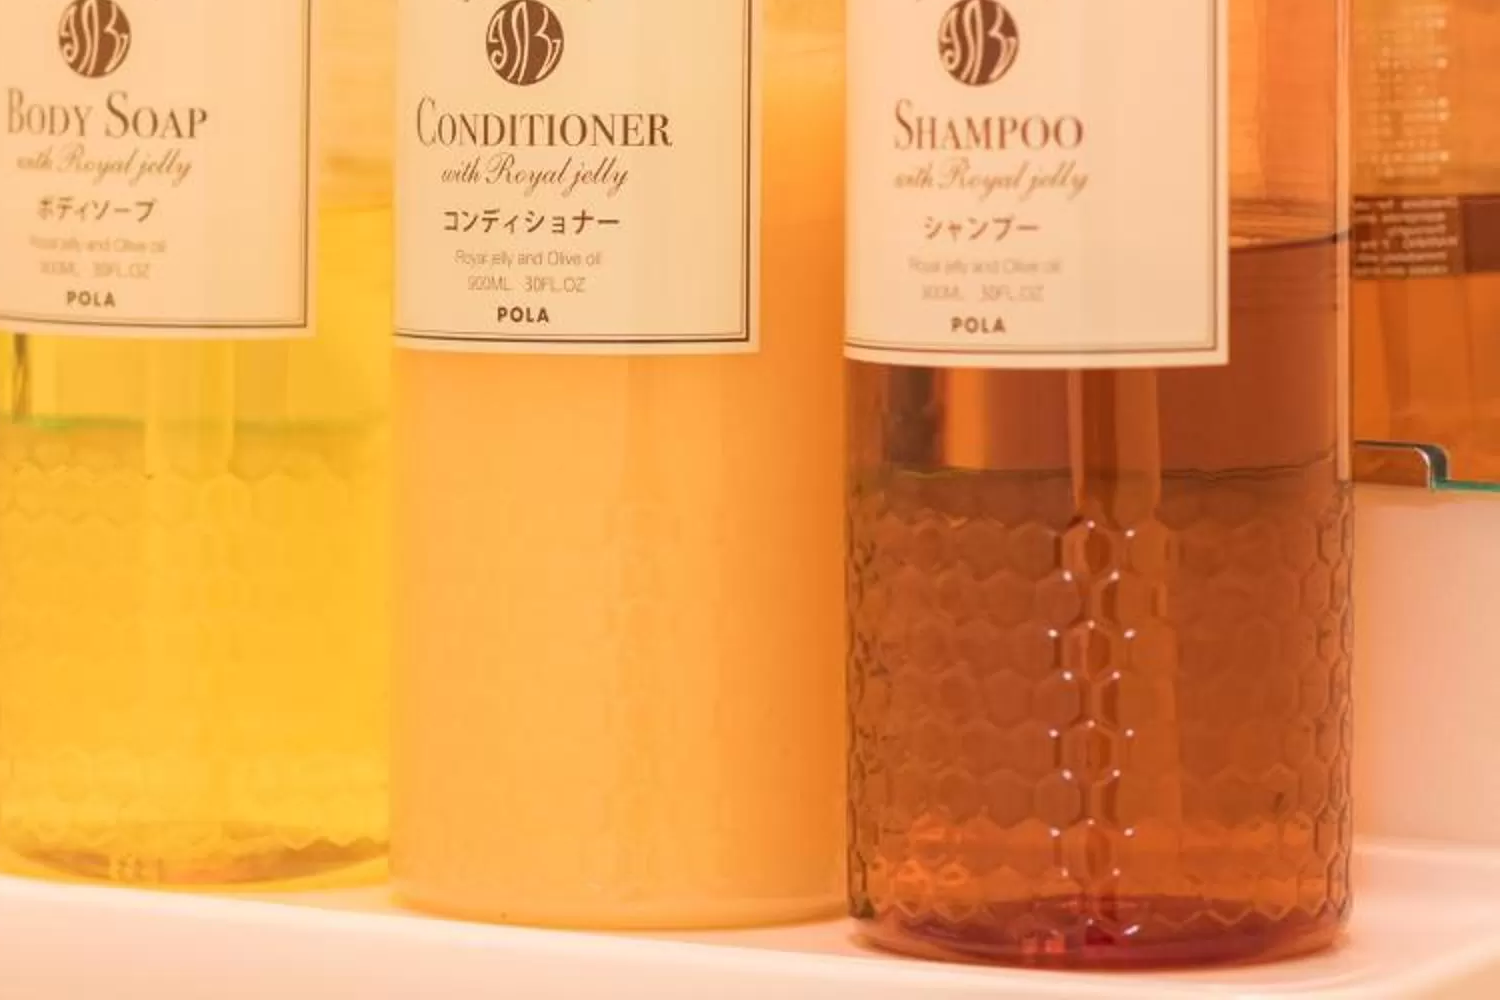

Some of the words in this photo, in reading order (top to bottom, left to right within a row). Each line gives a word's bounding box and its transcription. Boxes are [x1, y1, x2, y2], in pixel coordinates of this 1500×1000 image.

[7, 87, 93, 137] BODY
[104, 90, 208, 139] SOAP
[416, 96, 673, 147] CONDITIONER
[894, 97, 1084, 151] SHAMPOO
[56, 141, 140, 186] Royal
[128, 148, 192, 187] jelly
[441, 156, 481, 184] with
[485, 152, 572, 197] Royal
[561, 156, 629, 198] jelly
[936, 156, 1029, 202] Royal
[1018, 160, 1088, 202] jelly
[443, 208, 621, 235] コンディショナー
[923, 213, 1041, 241] シャンプー
[517, 251, 543, 266] and
[66, 290, 116, 307] POLA
[497, 306, 549, 323] POLA
[952, 316, 1006, 334] POLA
